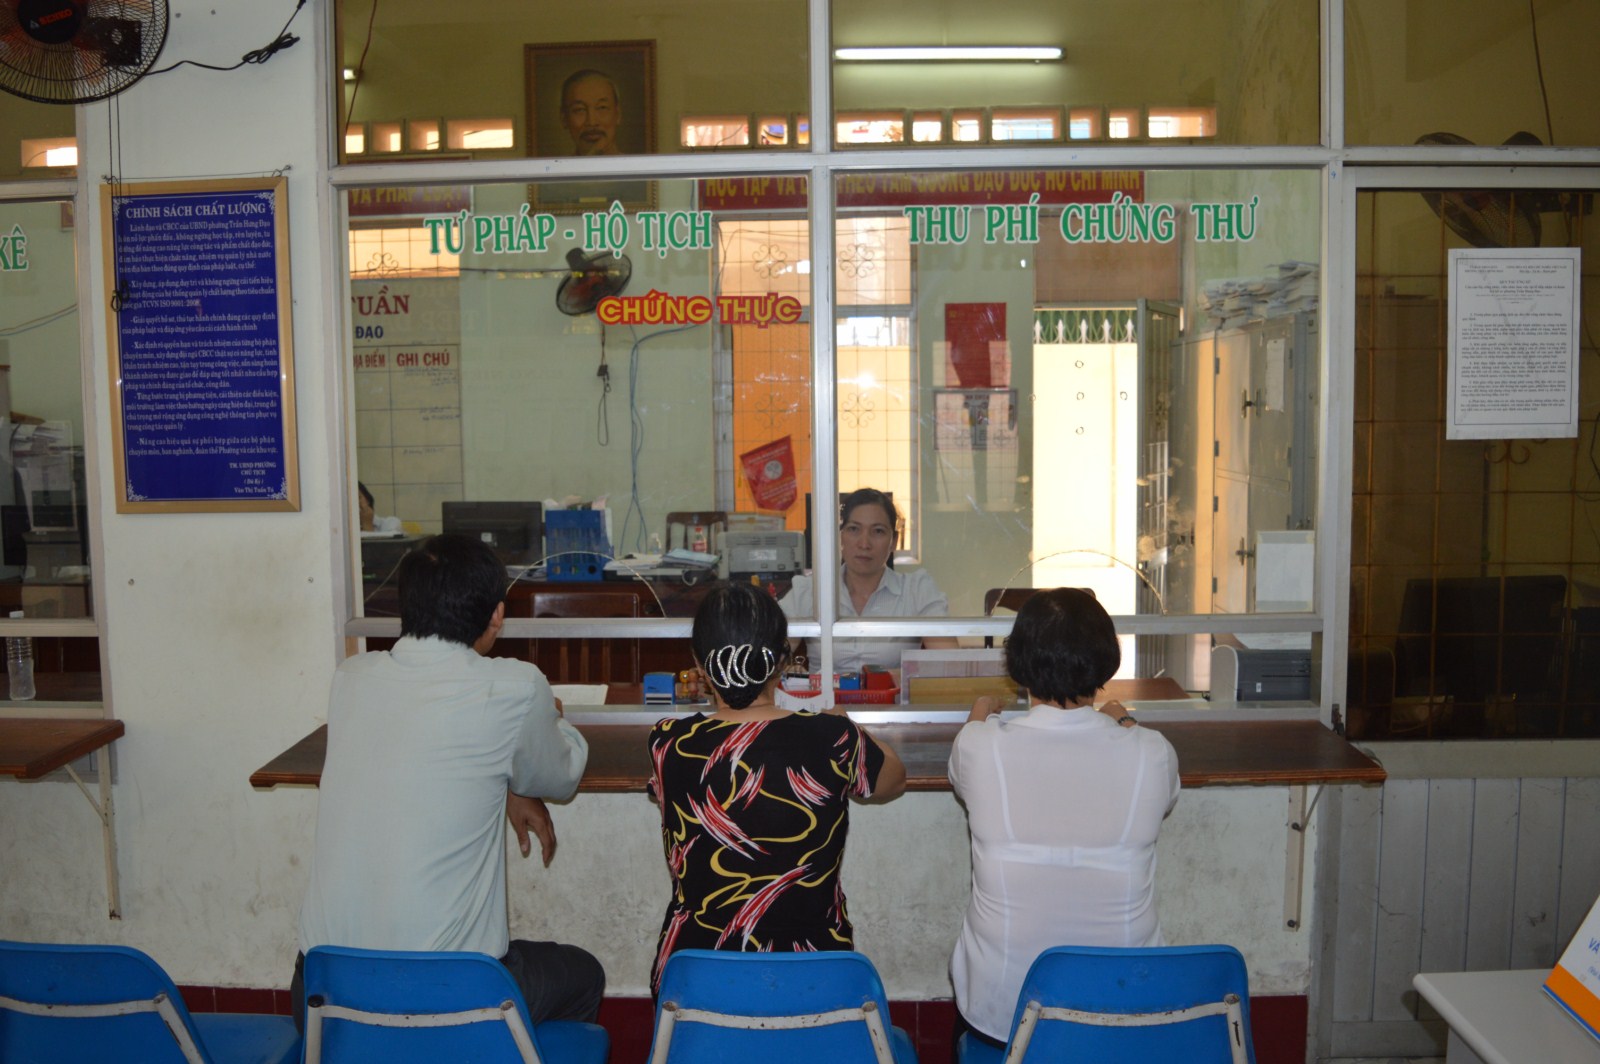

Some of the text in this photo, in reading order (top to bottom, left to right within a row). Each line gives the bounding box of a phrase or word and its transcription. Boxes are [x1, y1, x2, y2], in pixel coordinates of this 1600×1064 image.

[126, 200, 265, 218] CHÍNH SÁCH CHẤT LƯỢNG
[904, 191, 1260, 244] THU PHÍ CHỨNG THƯ
[424, 210, 468, 255] TƯ
[473, 203, 556, 254] PHÁP
[582, 201, 629, 258] HỘ
[637, 210, 714, 257] TỊCH
[351, 285, 410, 316] UẦN
[597, 289, 801, 328] CHỨNG THỰC
[396, 352, 419, 368] GHI
[423, 348, 451, 367] CHÚ
